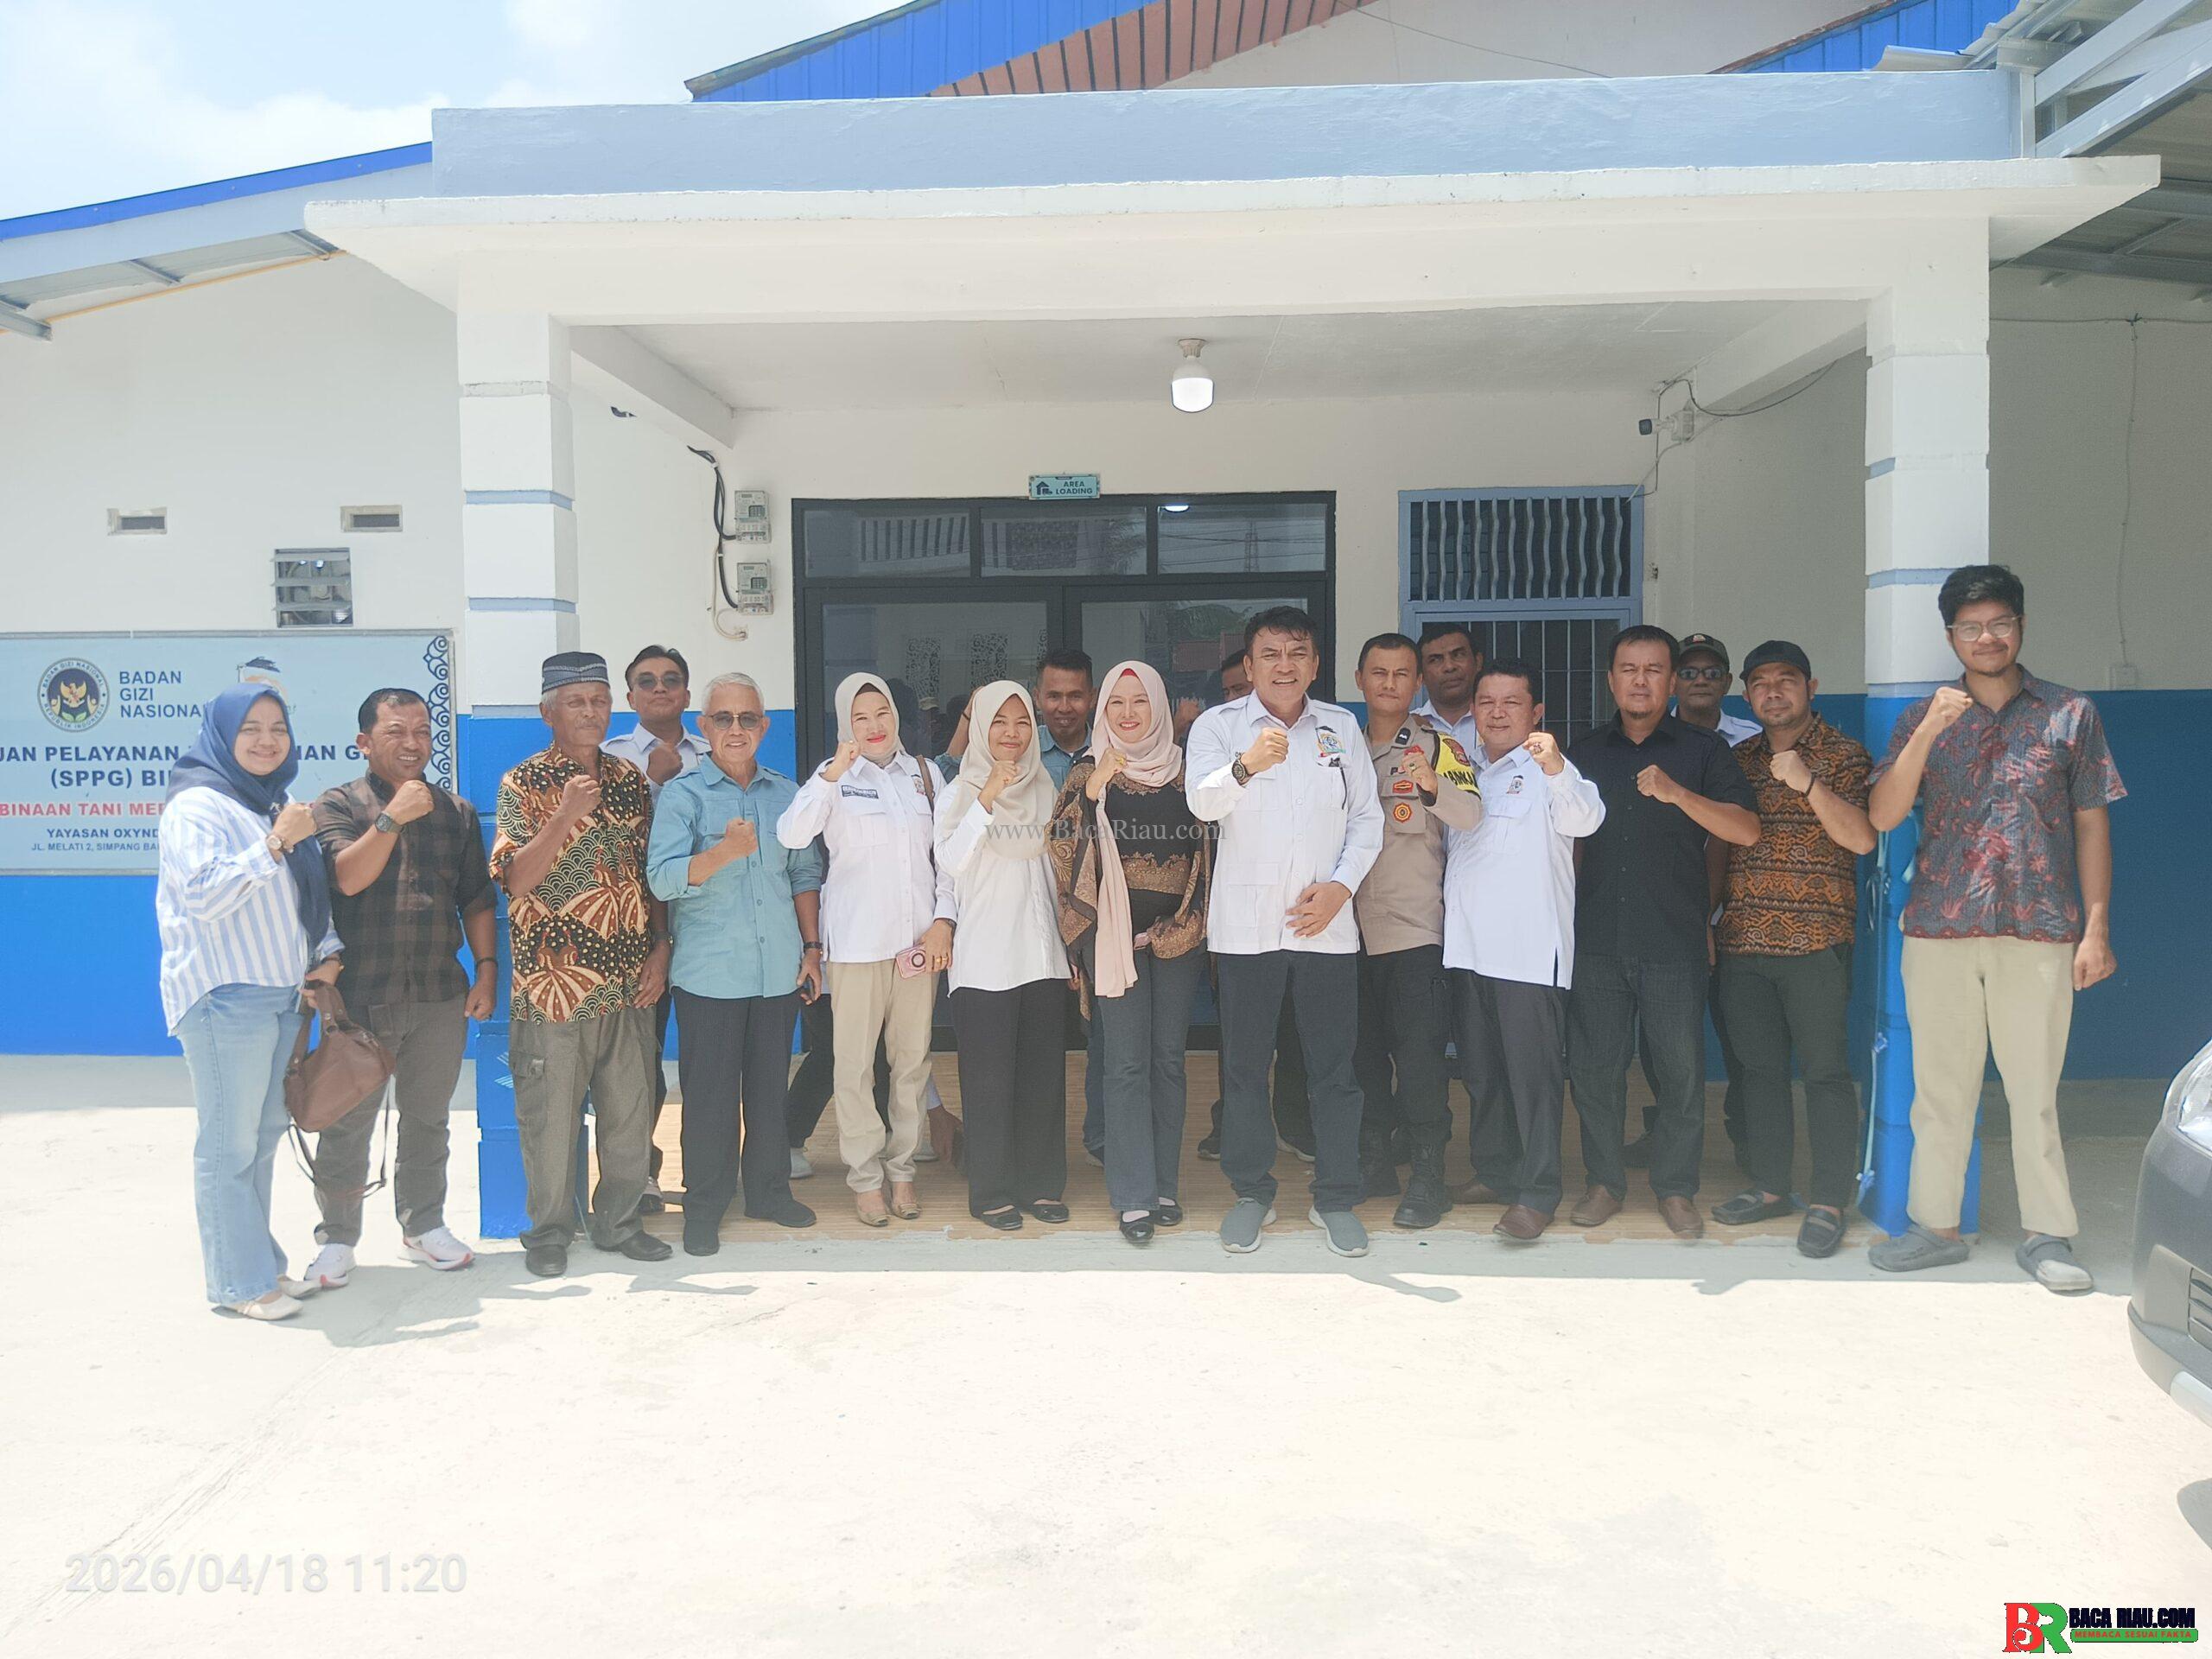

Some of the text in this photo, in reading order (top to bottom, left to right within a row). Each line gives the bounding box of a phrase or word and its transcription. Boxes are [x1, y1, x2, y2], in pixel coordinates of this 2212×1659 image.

[119, 671, 181, 684] BADAN
[119, 688, 154, 702] GIZI
[45, 746, 179, 761] PELAYANAN
[51, 767, 133, 789] (SPPG)
[0, 803, 71, 816] BINAAN
[78, 803, 122, 816] TANI
[47, 829, 109, 838] YAYASAN
[48, 842, 83, 851] MELATI
[97, 842, 140, 851] SIMPANG
[143, 842, 160, 850] BA
